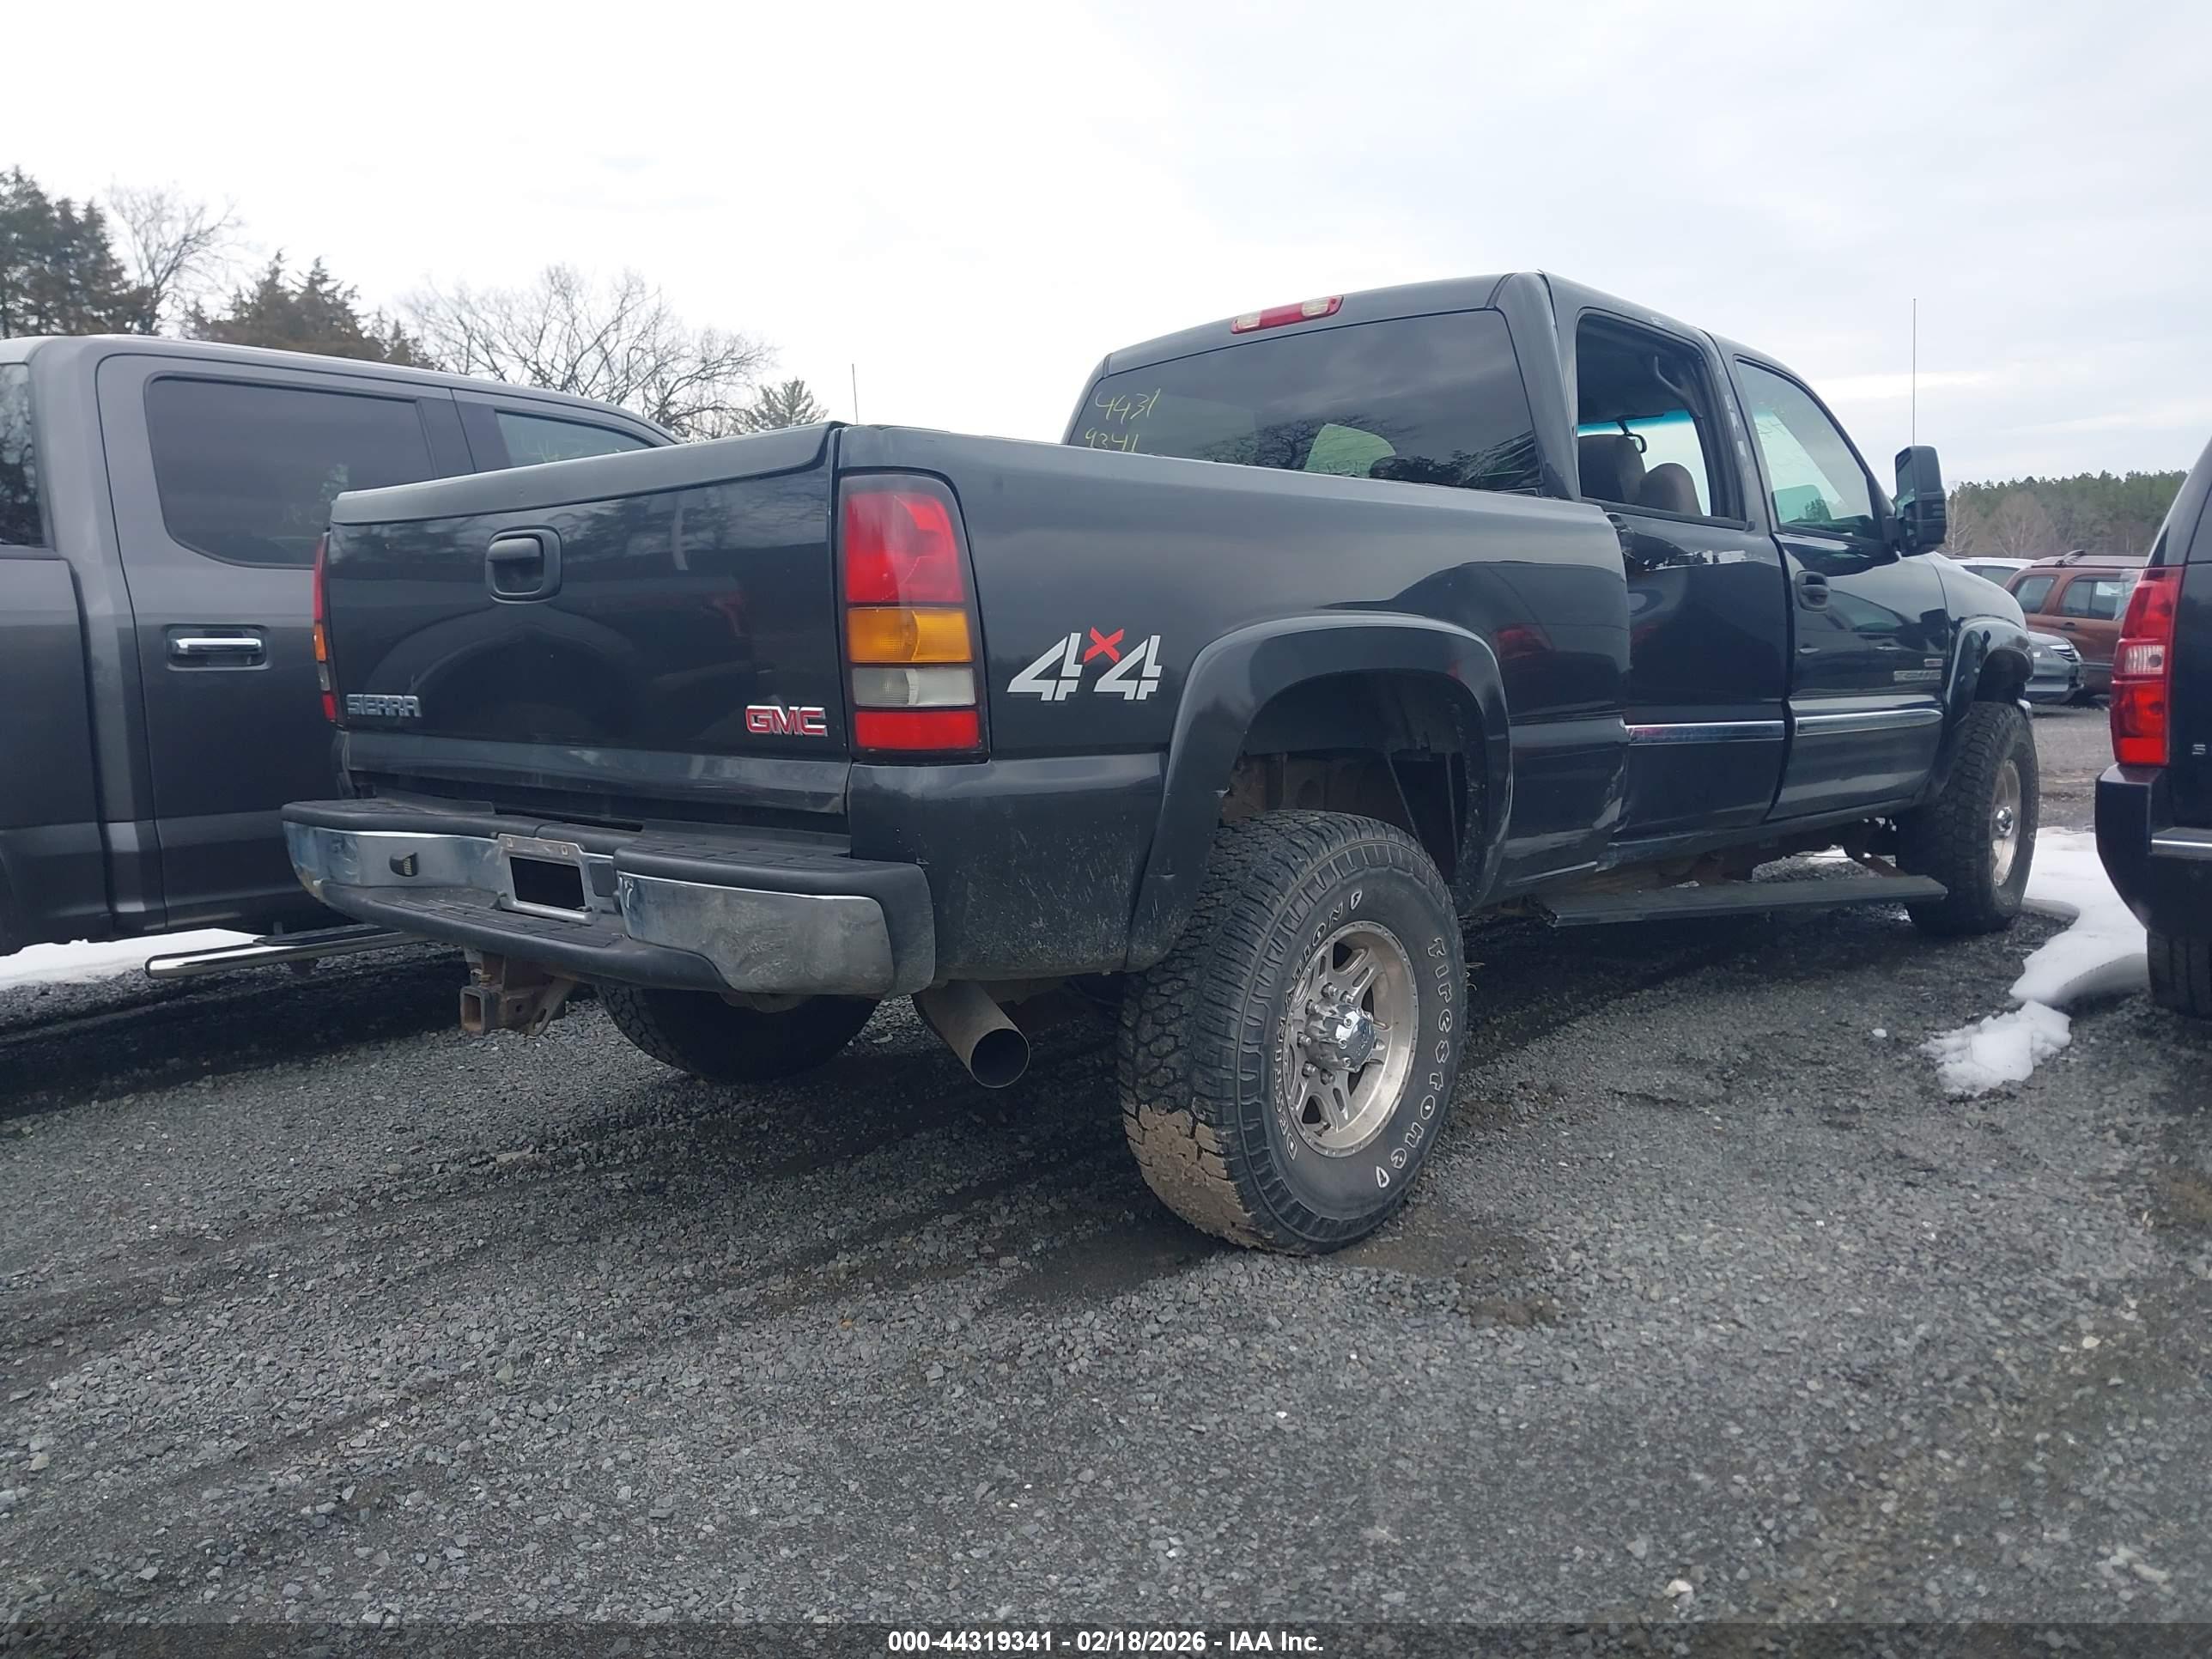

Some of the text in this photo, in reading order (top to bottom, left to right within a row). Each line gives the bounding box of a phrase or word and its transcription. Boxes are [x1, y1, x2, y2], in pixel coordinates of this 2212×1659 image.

[1095, 387, 1161, 424] 4431
[1085, 428, 1140, 453] 9341
[346, 693, 422, 718] SIERRA
[745, 705, 829, 737] GMC
